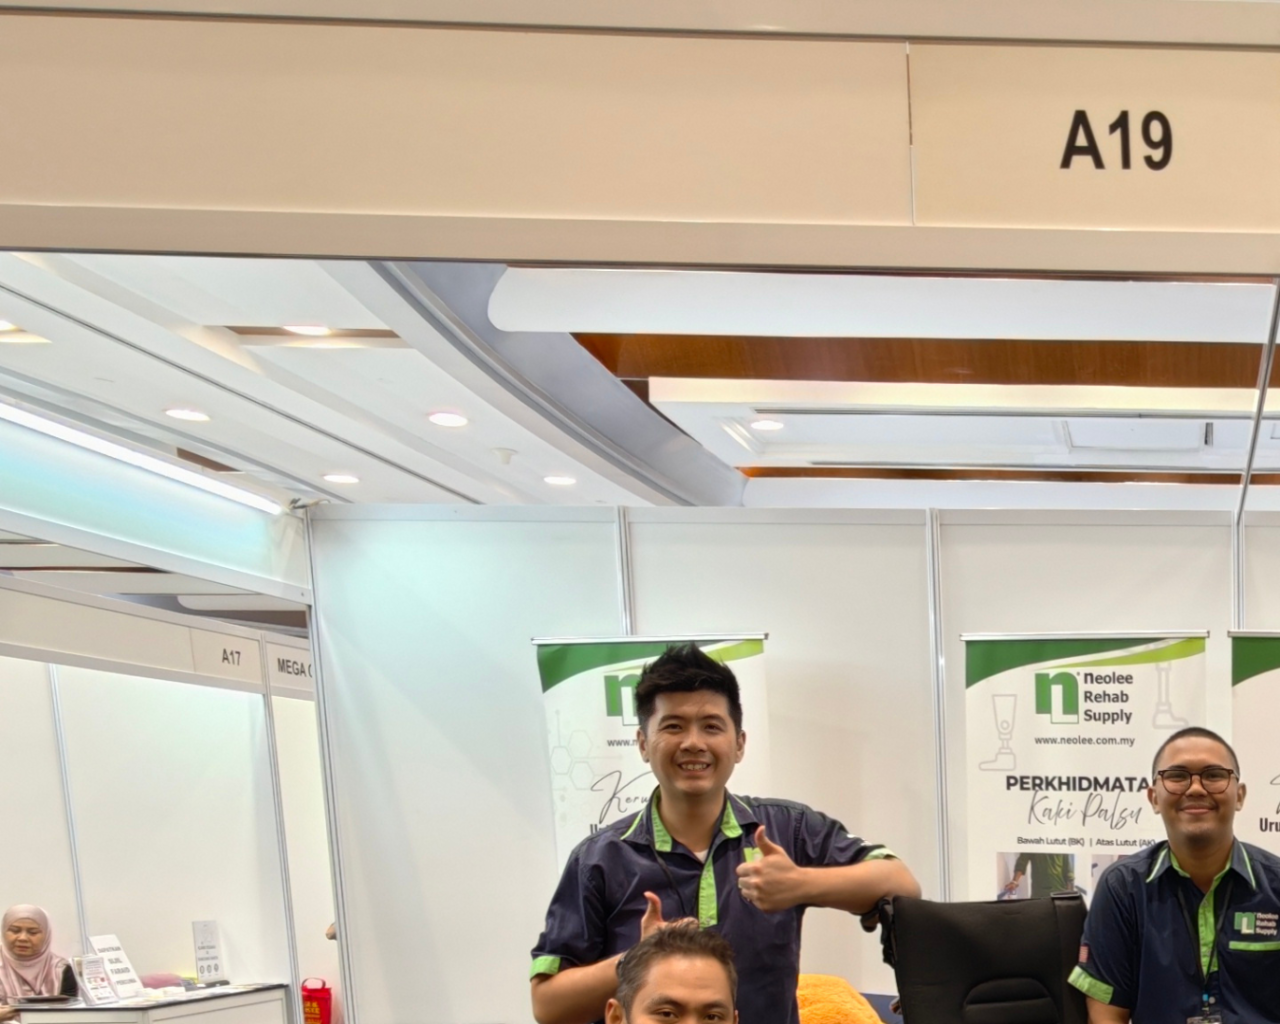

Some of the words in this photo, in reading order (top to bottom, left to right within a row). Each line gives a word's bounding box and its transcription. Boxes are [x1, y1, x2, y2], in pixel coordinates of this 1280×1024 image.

[1060, 110, 1172, 171] A19
[222, 648, 241, 666] A17
[277, 658, 307, 677] MEGA
[1084, 671, 1133, 684] neolee
[1084, 690, 1129, 703] Rehab
[1083, 709, 1132, 724] Supply
[1034, 735, 1135, 747] www.neolee.com.my
[1006, 775, 1149, 792] PERKHIDMATA
[1028, 789, 1077, 825] Kaki
[1080, 790, 1142, 830] Palsu
[1017, 837, 1045, 845] Bawah
[1068, 838, 1085, 847] (BK)
[1116, 839, 1137, 847] Lutut
